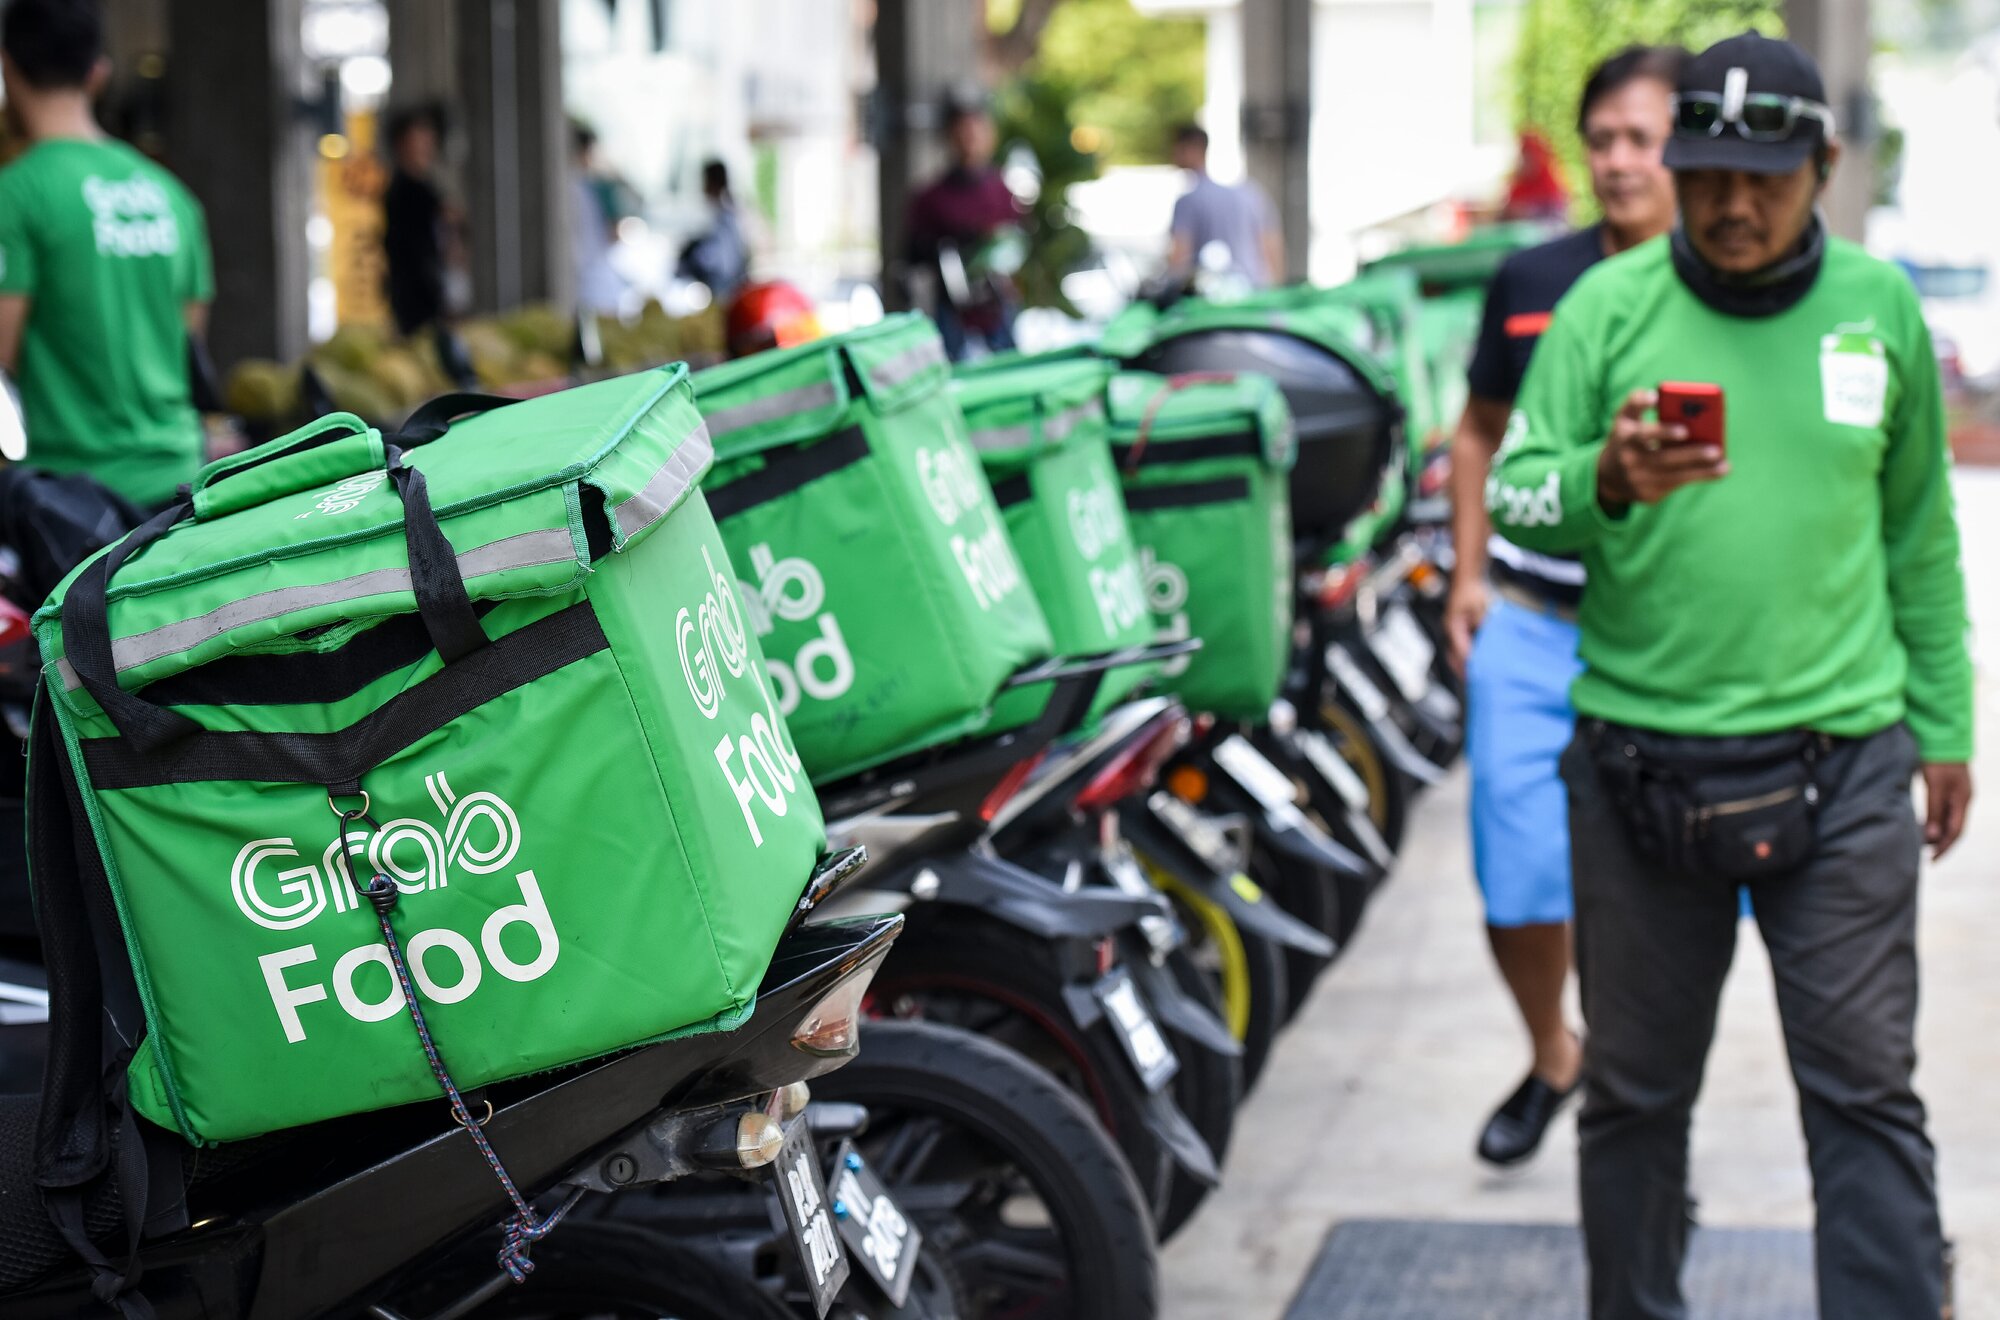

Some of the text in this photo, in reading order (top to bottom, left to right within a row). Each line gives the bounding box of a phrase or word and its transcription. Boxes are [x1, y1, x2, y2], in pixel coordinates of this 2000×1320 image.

[916, 422, 982, 525] Grab
[676, 544, 747, 719] Grab
[951, 506, 1018, 611] Food
[713, 660, 800, 848] Food
[231, 771, 521, 930] Grab
[258, 870, 560, 1043] Food
